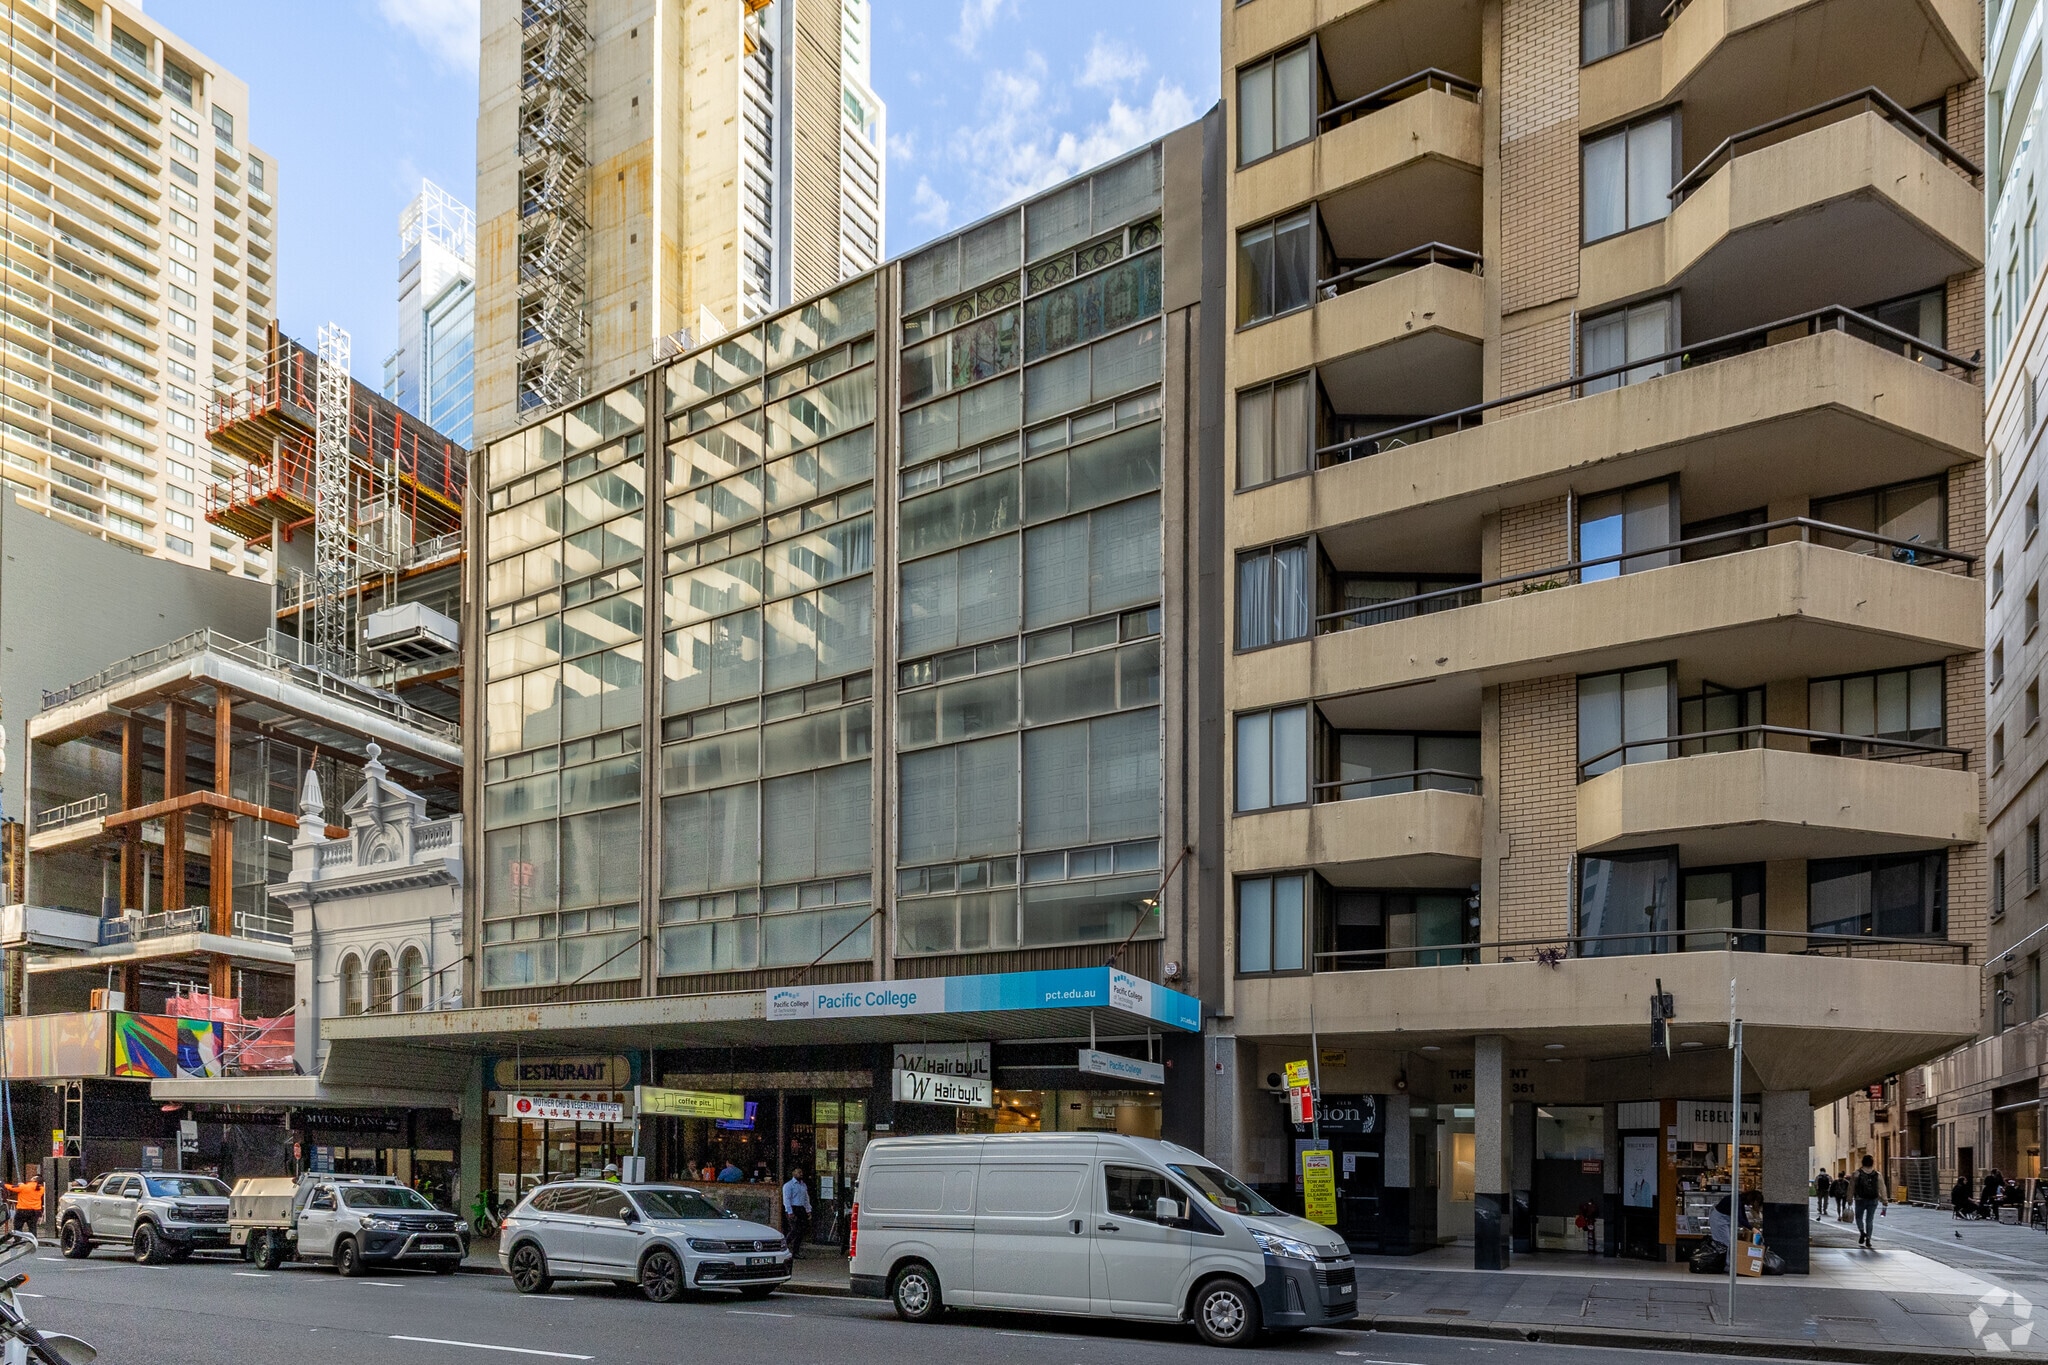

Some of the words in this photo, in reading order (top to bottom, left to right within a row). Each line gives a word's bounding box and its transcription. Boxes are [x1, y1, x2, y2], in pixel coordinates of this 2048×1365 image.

[818, 992, 862, 1009] Pacific
[865, 990, 917, 1009] College
[1045, 988, 1097, 1002] pct.edu.au
[1113, 984, 1127, 997] Pacific
[1127, 989, 1143, 1003] College
[790, 1000, 809, 1008] College
[514, 1062, 606, 1081] RESTAURANT
[927, 1058, 953, 1074] Hair
[1109, 1060, 1125, 1072] Pacific
[1125, 1063, 1142, 1076] College
[1448, 1069, 1473, 1079] THE
[906, 1072, 932, 1100] W
[934, 1082, 956, 1099] Hair
[1512, 1083, 1535, 1093] 361
[533, 1098, 555, 1108] MOTHER
[571, 1100, 600, 1111] VEGETARIAN
[600, 1102, 620, 1112] KITCHEN
[678, 1097, 698, 1106] coffee
[306, 1113, 351, 1124] MYUNG
[354, 1117, 383, 1126] JANG
